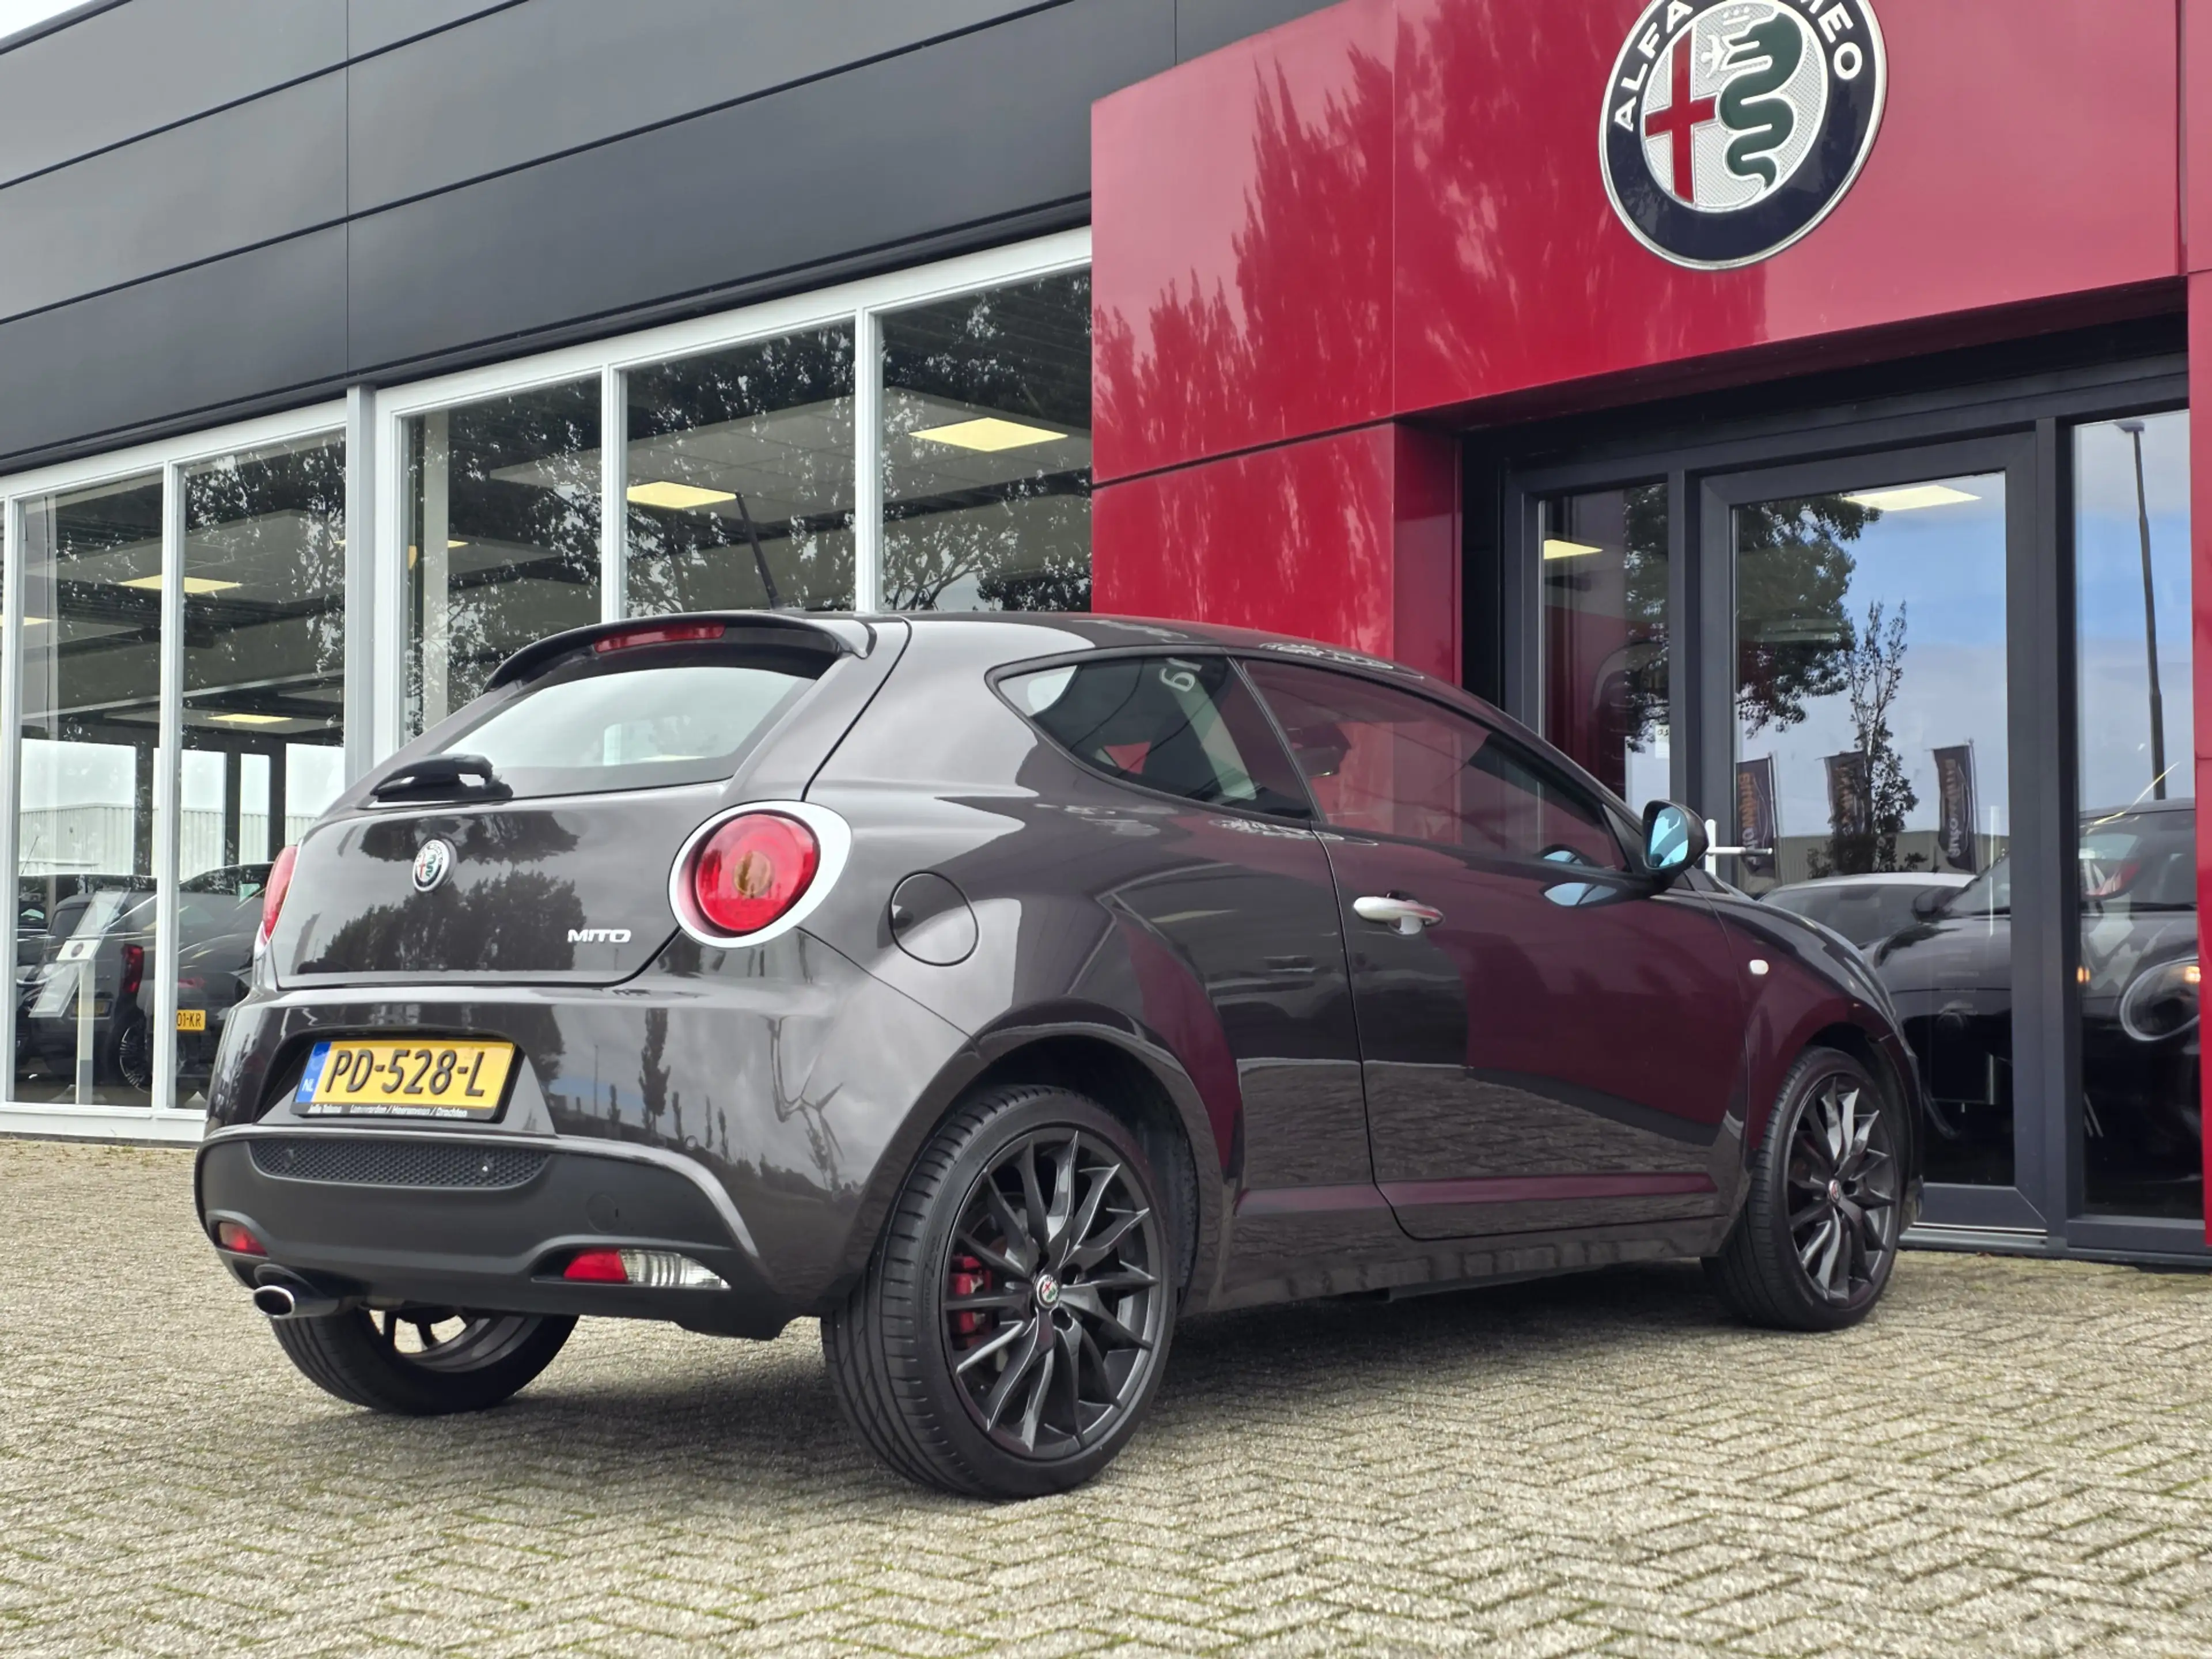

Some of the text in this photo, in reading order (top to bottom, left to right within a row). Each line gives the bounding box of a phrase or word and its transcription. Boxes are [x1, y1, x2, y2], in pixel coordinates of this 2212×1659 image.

[1614, 1, 1694, 132] ALFA
[567, 929, 632, 944] MITO
[301, 1078, 315, 1093] NL
[324, 1047, 485, 1097] PD-528-L
